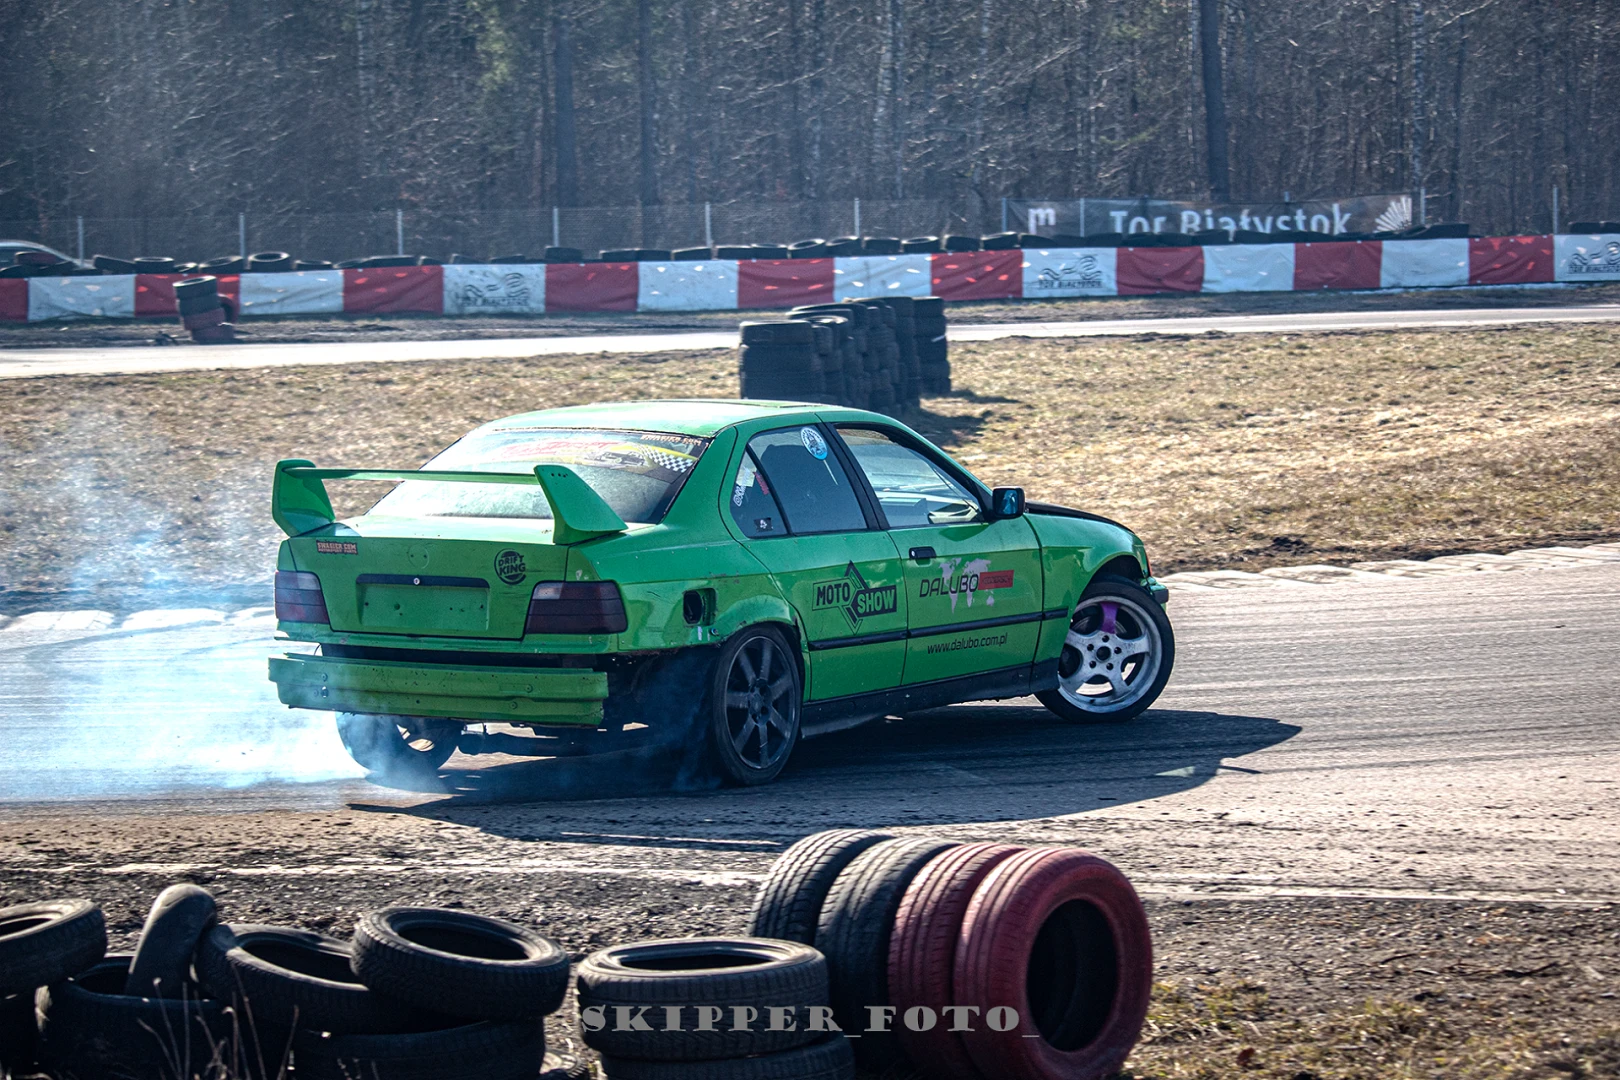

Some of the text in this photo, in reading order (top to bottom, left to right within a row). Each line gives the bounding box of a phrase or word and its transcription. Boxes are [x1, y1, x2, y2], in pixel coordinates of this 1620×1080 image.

[1109, 210, 1167, 234] Tor
[498, 555, 525, 567] DRIFT
[499, 562, 526, 576] KING
[816, 582, 850, 606] MOTO
[919, 574, 979, 597] DALUBO
[857, 589, 895, 614] SHOW
[927, 632, 1008, 654] www.dalubo.com.pl
